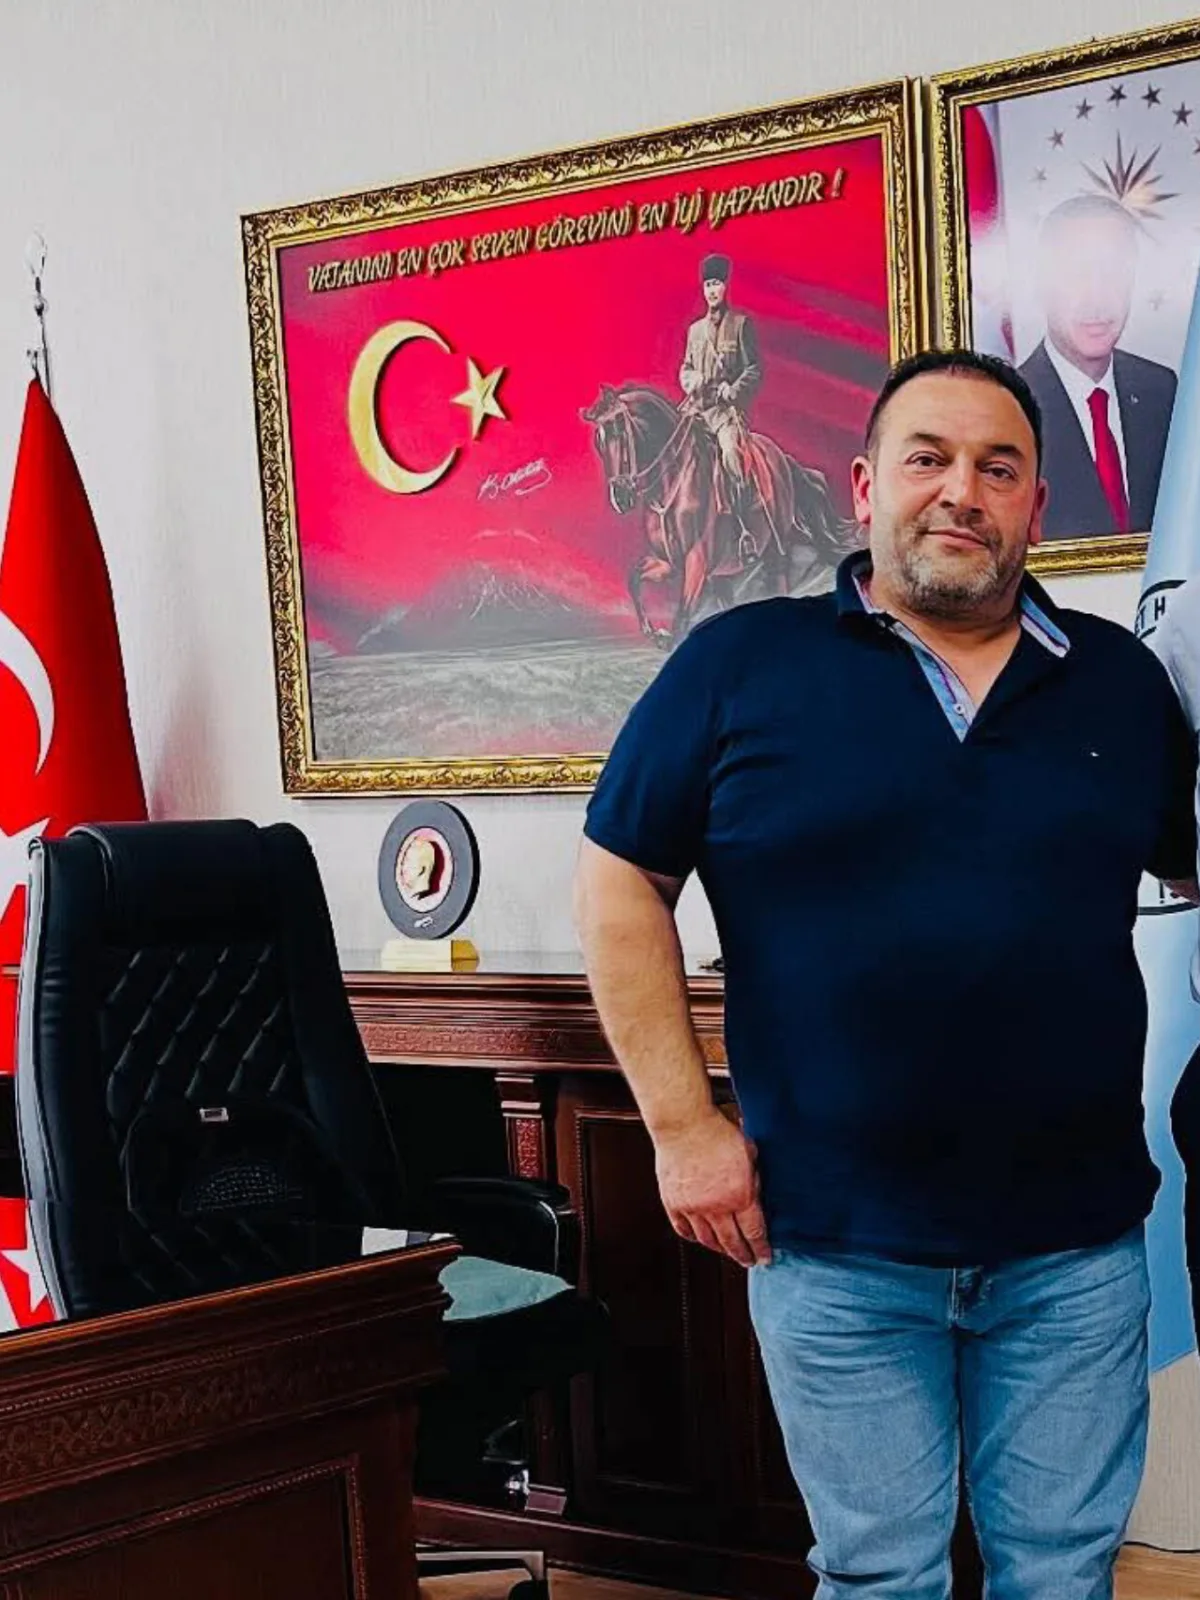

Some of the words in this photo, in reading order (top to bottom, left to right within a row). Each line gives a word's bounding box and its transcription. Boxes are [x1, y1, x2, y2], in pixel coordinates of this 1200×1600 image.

[308, 252, 392, 291] VATANINI
[397, 246, 422, 276] EN
[427, 239, 464, 277] ÇOK
[470, 226, 530, 262] SEVEN
[535, 200, 633, 250] GÖREVİNİ
[638, 202, 668, 232] EN
[672, 187, 704, 234] İYİ
[708, 171, 824, 228] YAPANDIR
